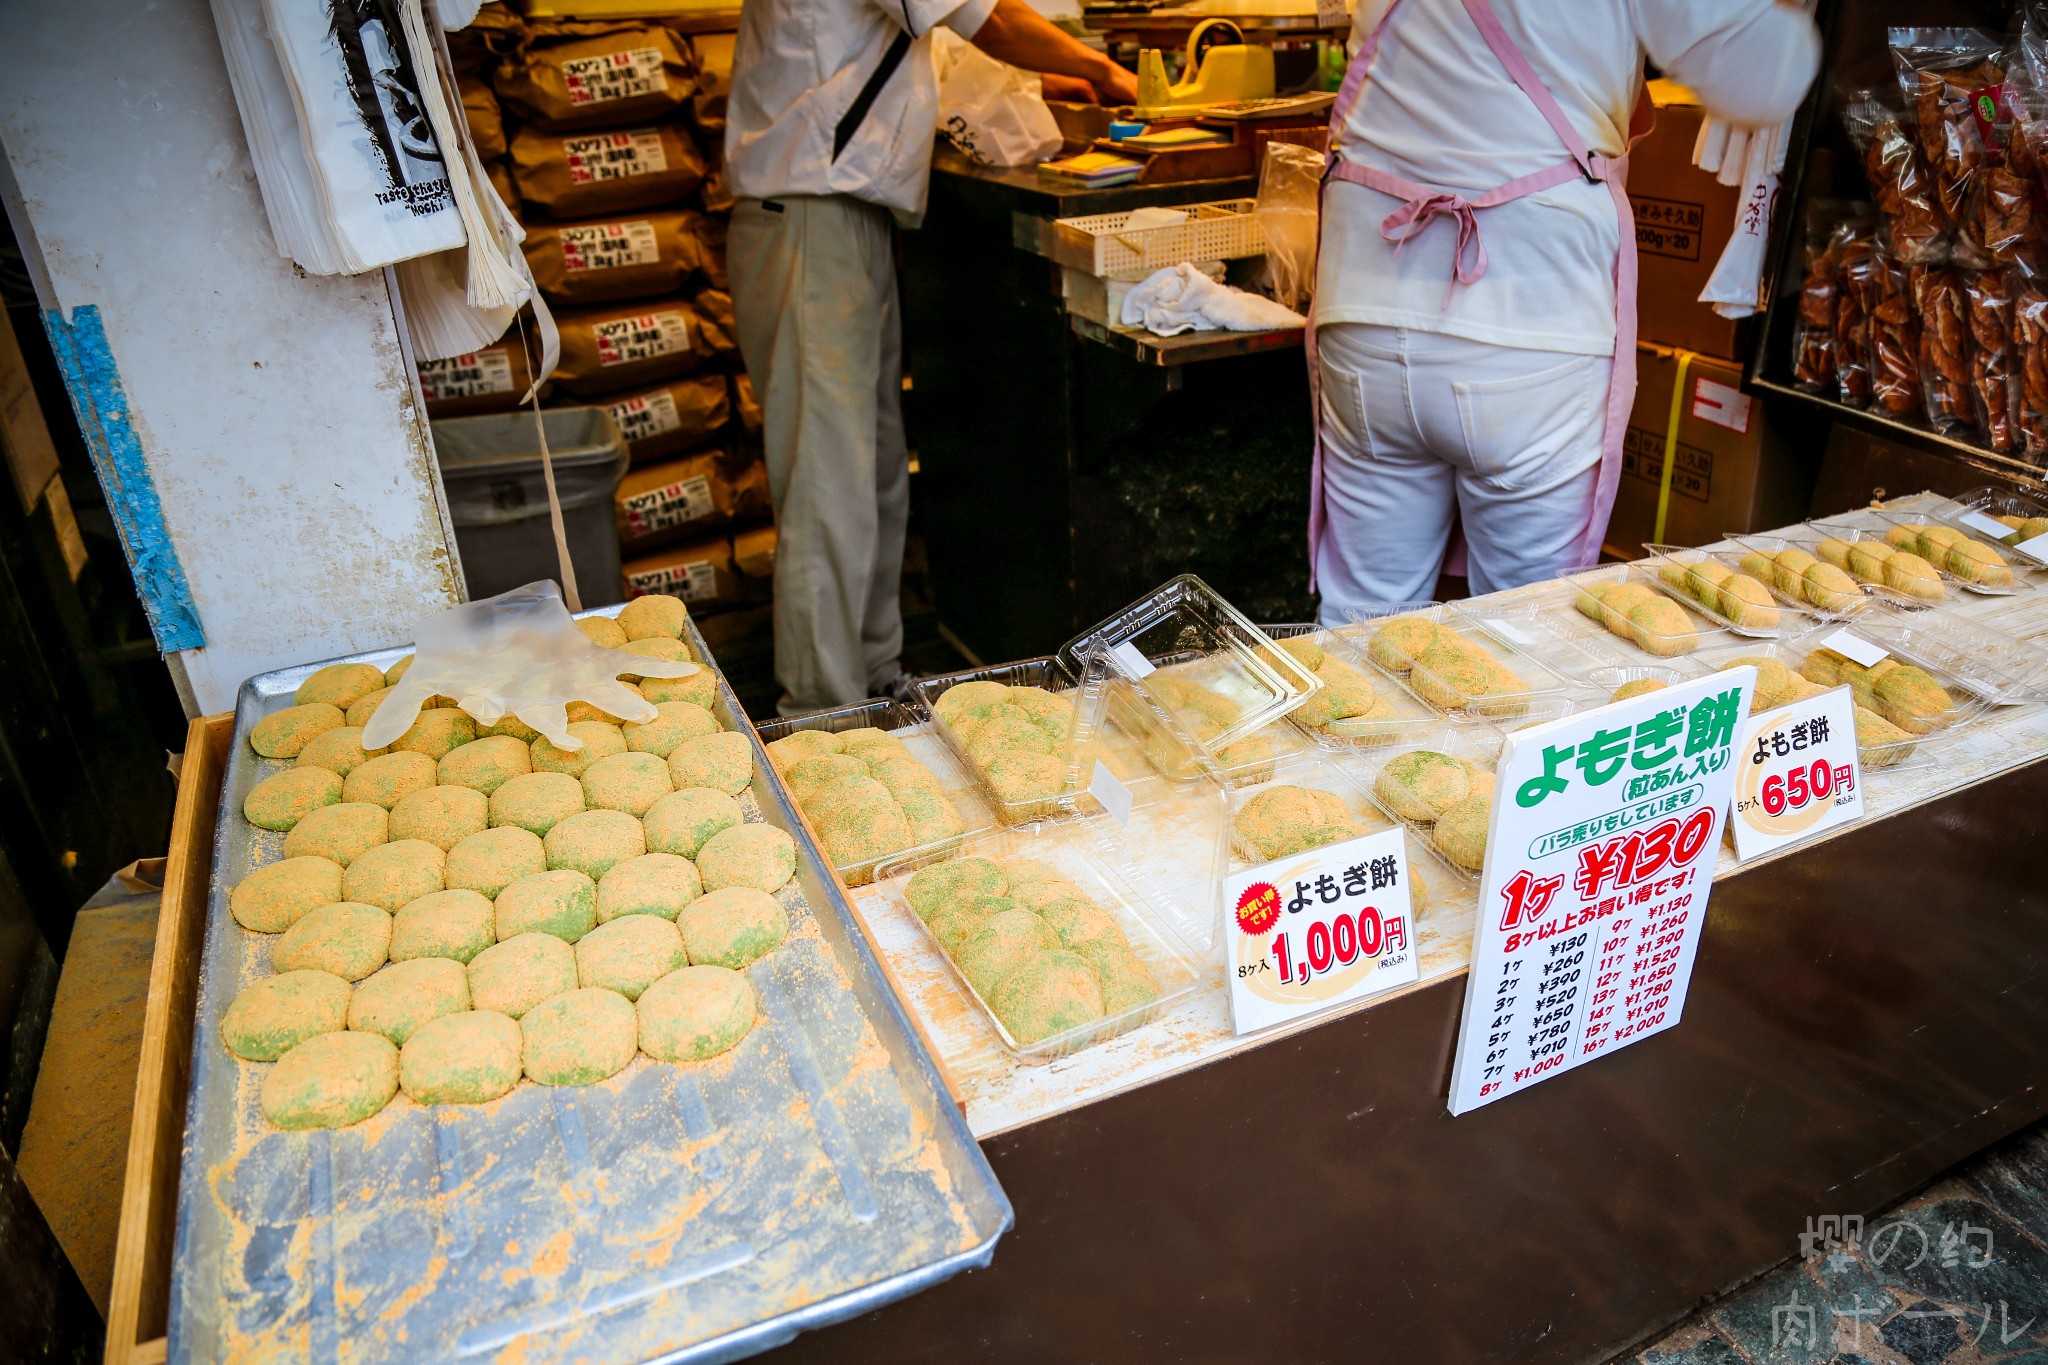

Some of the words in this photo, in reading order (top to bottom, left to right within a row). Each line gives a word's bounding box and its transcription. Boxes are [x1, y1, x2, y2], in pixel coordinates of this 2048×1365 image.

[375, 187, 408, 206] Taste
[412, 180, 440, 196] that
[1643, 438, 1709, 473] せんい久助
[1515, 687, 1742, 808] よもぎ餅
[1752, 715, 1829, 765] よもぎ餅
[1622, 747, 1730, 803] (粒あん入り)
[1762, 758, 1854, 817] 650円
[1540, 789, 1694, 854] バラ売りもしています
[1574, 806, 1716, 901] ¥130
[1287, 854, 1398, 914] よもぎ餅
[1238, 888, 1276, 920] お買い得
[1271, 906, 1407, 986] 1,000円
[1550, 933, 1587, 957] ¥130
[1543, 951, 1584, 976] ¥260
[1538, 968, 1580, 994] ¥390
[1533, 1003, 1574, 1028] ¥650
[1535, 986, 1577, 1012] ¥520
[1527, 1020, 1570, 1046] ¥780
[1530, 1037, 1567, 1060] ¥910
